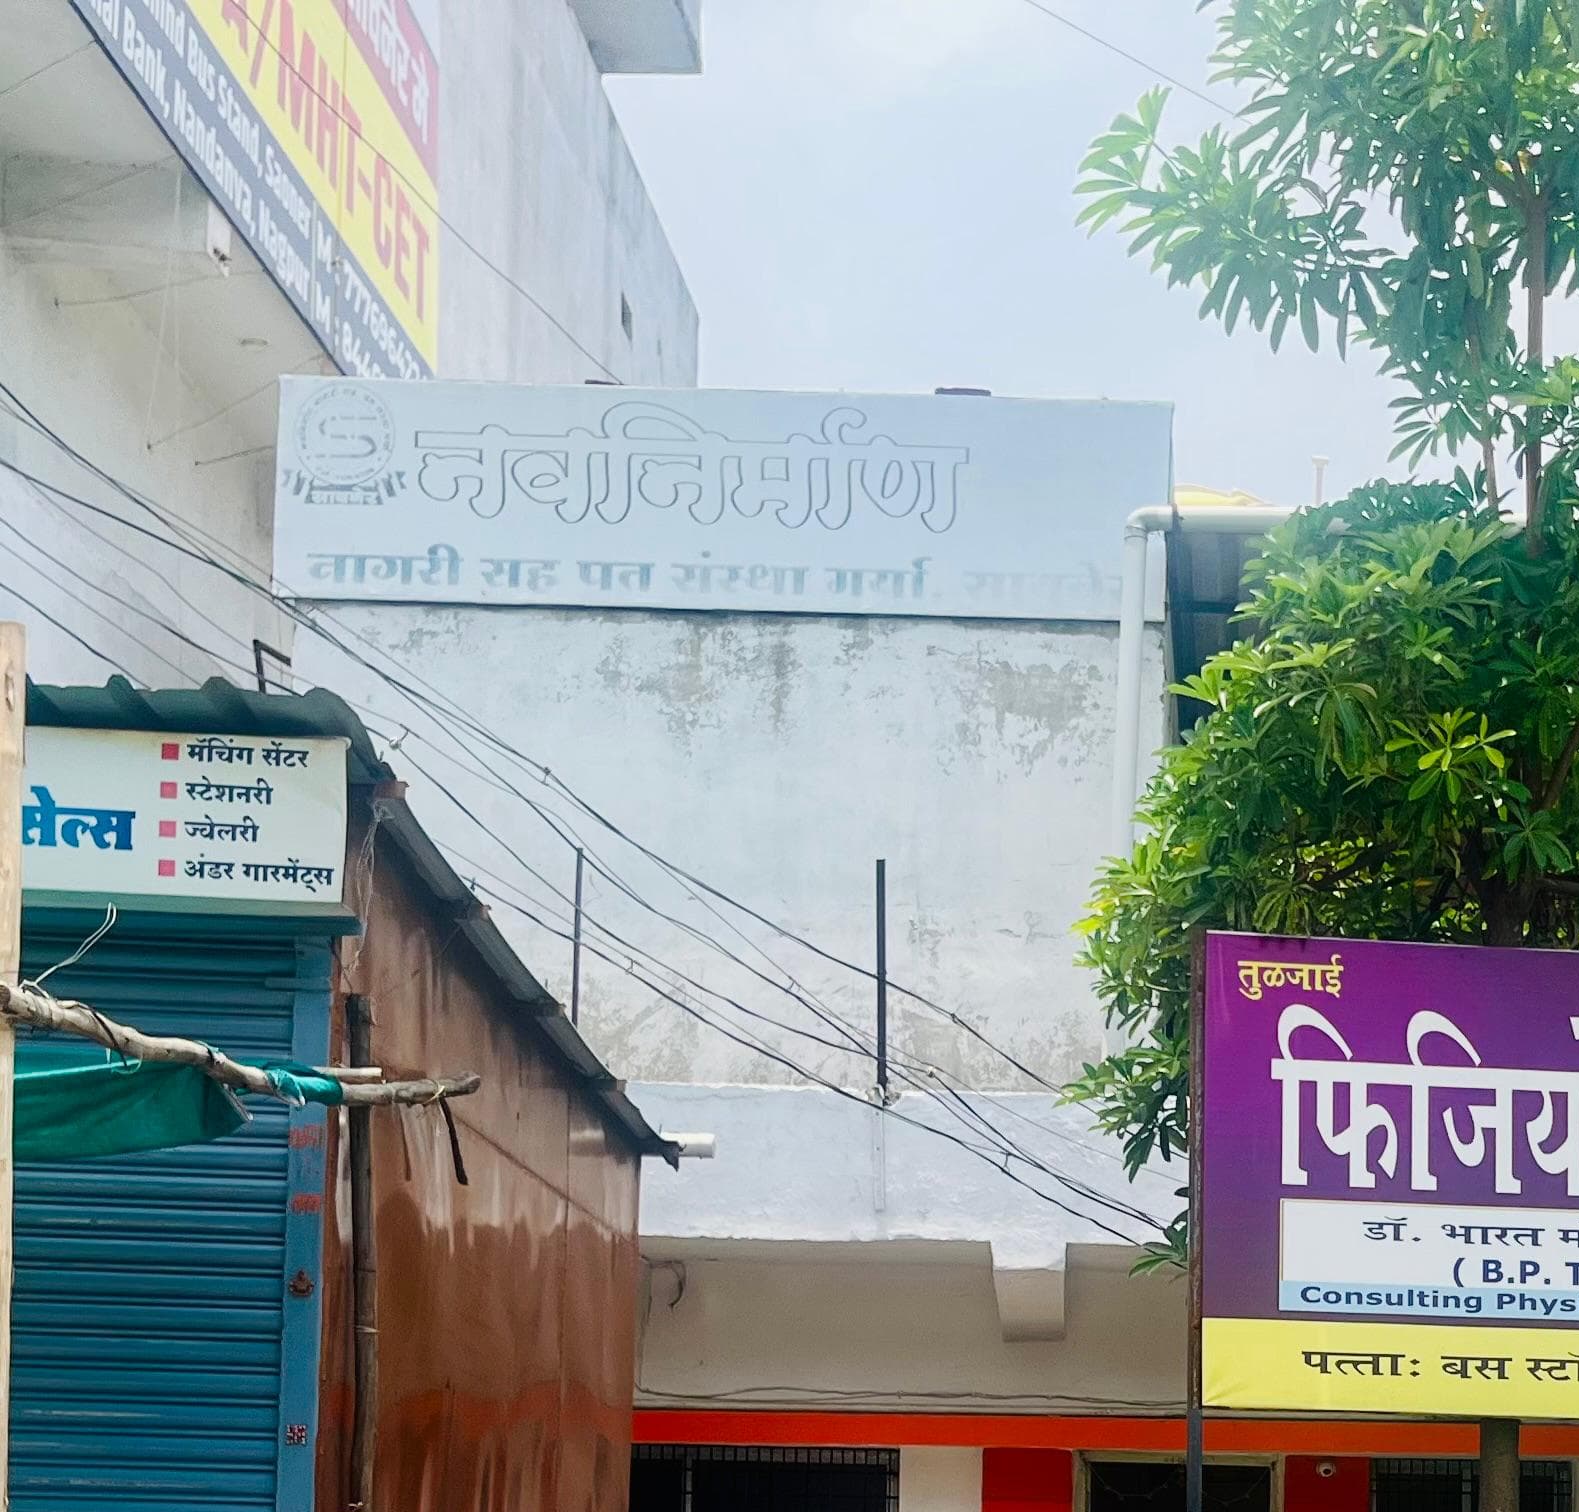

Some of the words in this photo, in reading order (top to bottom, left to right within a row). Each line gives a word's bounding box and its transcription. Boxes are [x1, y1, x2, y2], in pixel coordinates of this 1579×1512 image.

[123, 5, 170, 119] Bank,
[187, 27, 215, 101] Bus
[307, 543, 464, 586] नागरी
[480, 557, 562, 588] सह
[185, 775, 273, 805] स्टेशनरी
[184, 814, 259, 842] ज्वेलरी
[184, 853, 234, 881] अंडर
[242, 857, 334, 892] गारमेंट्स
[1237, 954, 1344, 1000] तुळजाई
[1362, 1216, 1422, 1244] डॉ.
[1440, 1223, 1545, 1248] भारत
[1299, 1286, 1484, 1314] Consulting
[1440, 1355, 1513, 1380] बस
